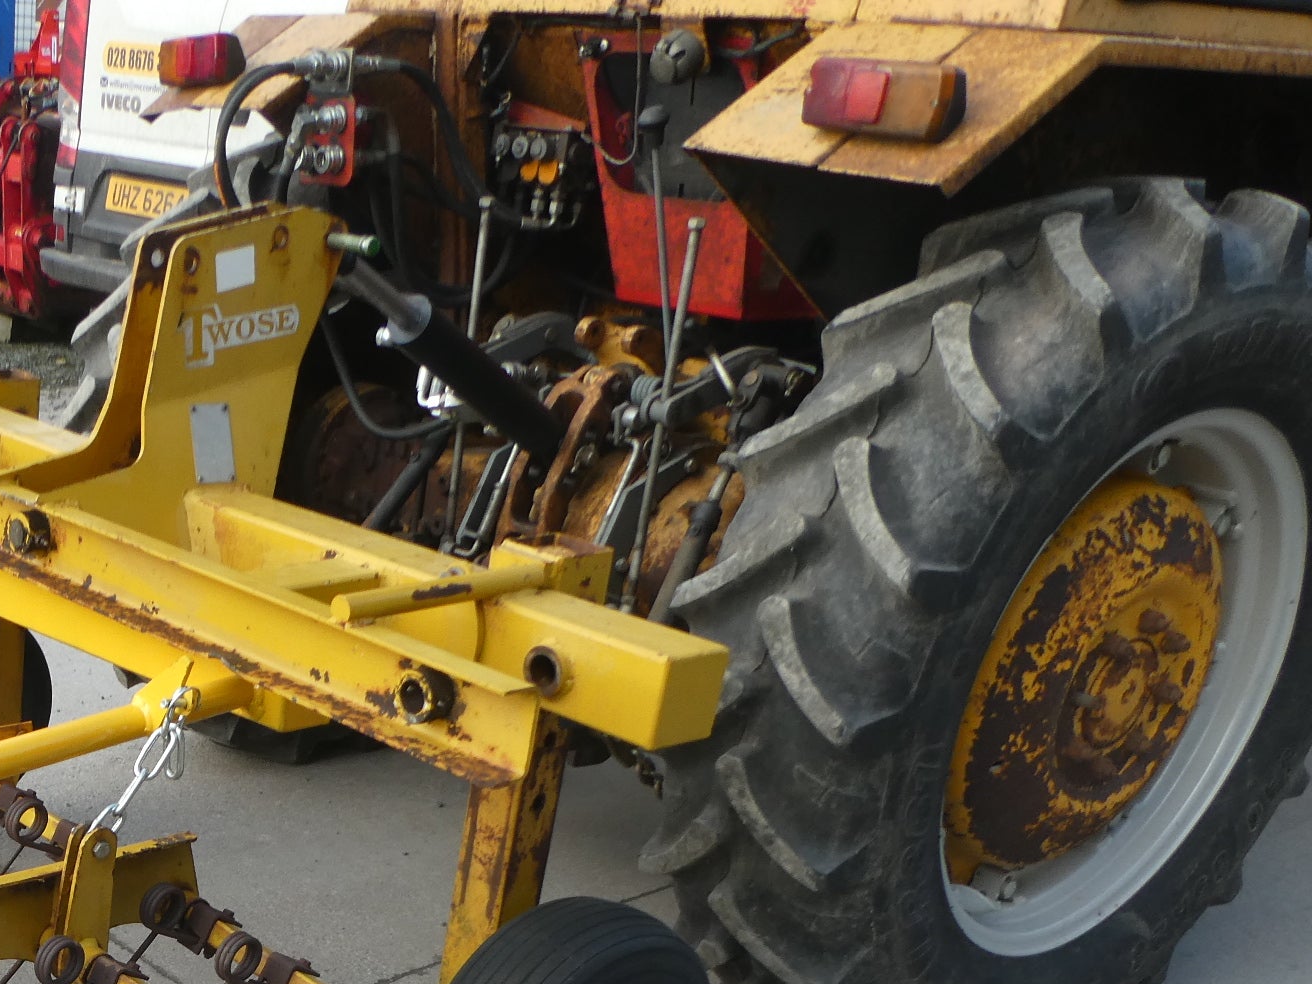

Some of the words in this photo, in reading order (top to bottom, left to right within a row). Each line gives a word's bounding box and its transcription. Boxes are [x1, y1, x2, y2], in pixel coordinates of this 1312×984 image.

[107, 47, 126, 68] 028
[129, 49, 155, 71] 8676
[100, 93, 142, 113] IVECO
[112, 183, 141, 210] UHZ
